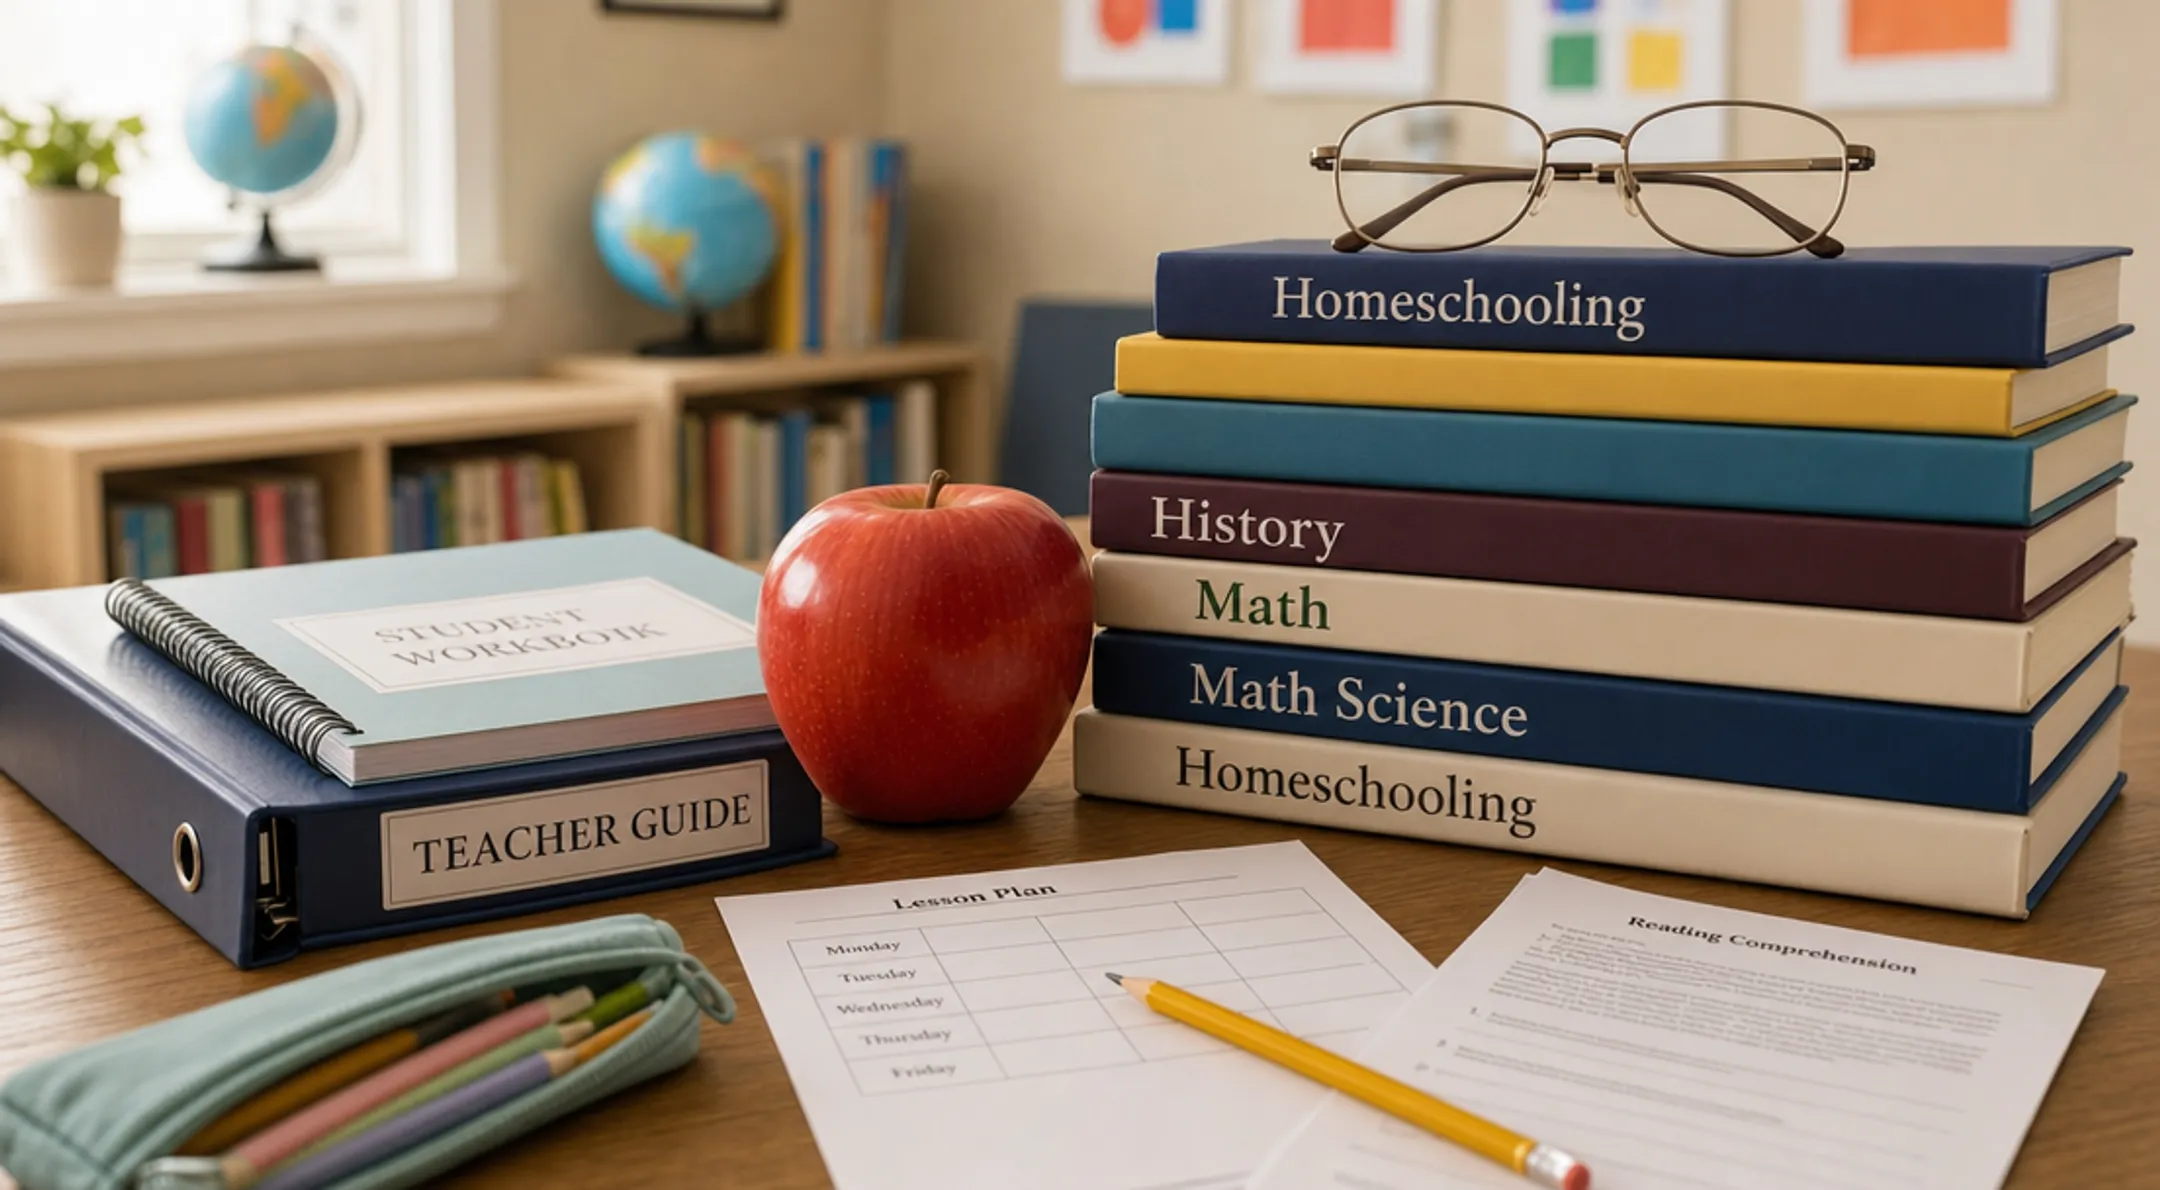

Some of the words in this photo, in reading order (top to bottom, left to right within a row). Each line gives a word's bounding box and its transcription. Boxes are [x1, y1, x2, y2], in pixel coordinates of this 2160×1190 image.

[1273, 277, 1646, 342] Homeschooling
[1151, 497, 1345, 563] History
[375, 608, 586, 643] STUDENT
[1195, 579, 1330, 630] Math
[1190, 663, 1318, 717] Math
[1335, 677, 1529, 737] Science
[1176, 745, 1537, 839] Homeschooling
[413, 813, 619, 875] TEACHER
[631, 794, 752, 842] GUIDE
[893, 891, 986, 910] Lesson
[994, 884, 1057, 899] Plan
[826, 940, 901, 956] Monday
[1628, 916, 1723, 944] Reading
[1729, 935, 1917, 975] Comprehension
[840, 967, 916, 984] Tuesday
[837, 996, 944, 1015] Wednesday
[862, 1028, 951, 1047] Thursday
[891, 1062, 956, 1080] Friday
